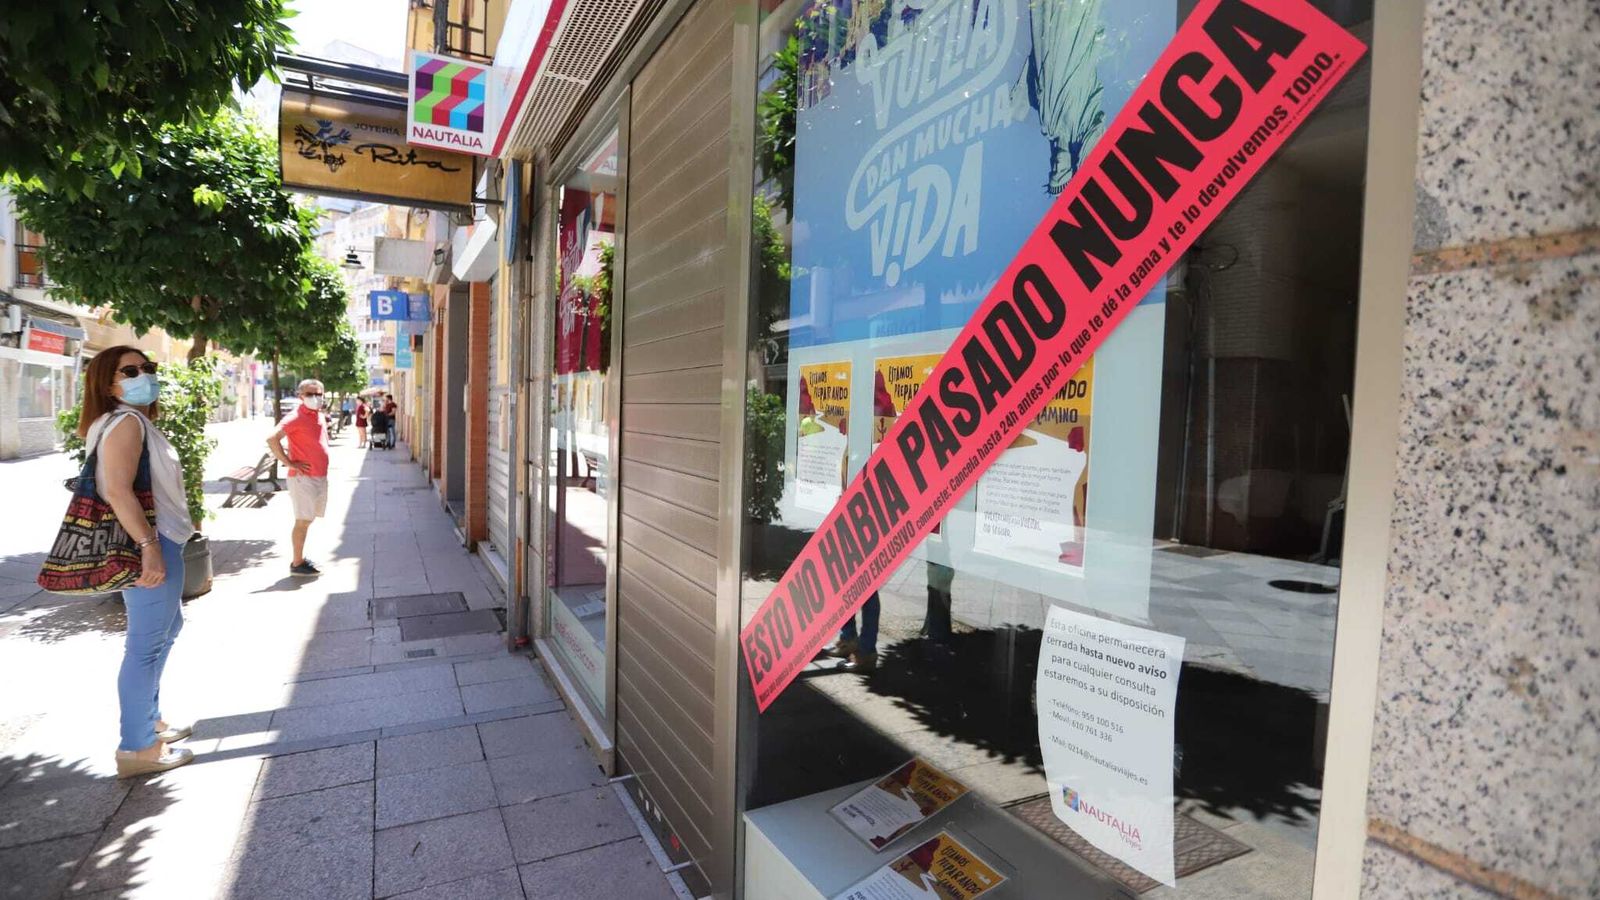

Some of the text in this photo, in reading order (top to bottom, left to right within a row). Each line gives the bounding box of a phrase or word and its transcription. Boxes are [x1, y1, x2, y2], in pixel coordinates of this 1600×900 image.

[353, 143, 462, 172] Rita
[412, 126, 483, 149] NAUTALIA
[866, 83, 1013, 197] DAN MUCHA
[377, 295, 393, 316] B
[745, 597, 793, 684] ESTO
[787, 558, 825, 633] NO
[817, 458, 910, 594] HABÍA
[896, 263, 1067, 494] PASADO
[1049, 0, 1308, 293] NUNCA
[842, 570, 872, 609] SEGURO
[869, 520, 916, 580] EXCLUSIVO
[916, 507, 935, 530] como
[950, 454, 980, 493] Cancela
[976, 430, 1003, 461] hasta
[999, 413, 1019, 436] 24h
[1017, 383, 1044, 416] antes
[1042, 362, 1060, 390] por
[1058, 351, 1073, 368] lo
[1069, 328, 1092, 355] que
[1088, 314, 1104, 333] te
[1101, 295, 1119, 319] dé
[1114, 283, 1132, 302] la
[1128, 249, 1162, 288] gana
[1158, 236, 1172, 254] y
[1167, 221, 1187, 242] te
[1181, 204, 1201, 224] lo
[1197, 105, 1289, 208] devolvemos
[1282, 51, 1341, 105] TODO.
[1050, 618, 1066, 632] Esta
[1068, 623, 1097, 640] oficina
[1046, 635, 1167, 680] cerrada hasta nuevo aviso
[1051, 654, 1157, 696] para cualquier consulta
[1044, 668, 1166, 719] estaremos a su disposición
[1096, 717, 1110, 728] 100
[1079, 799, 1142, 842] NAUTALIA
